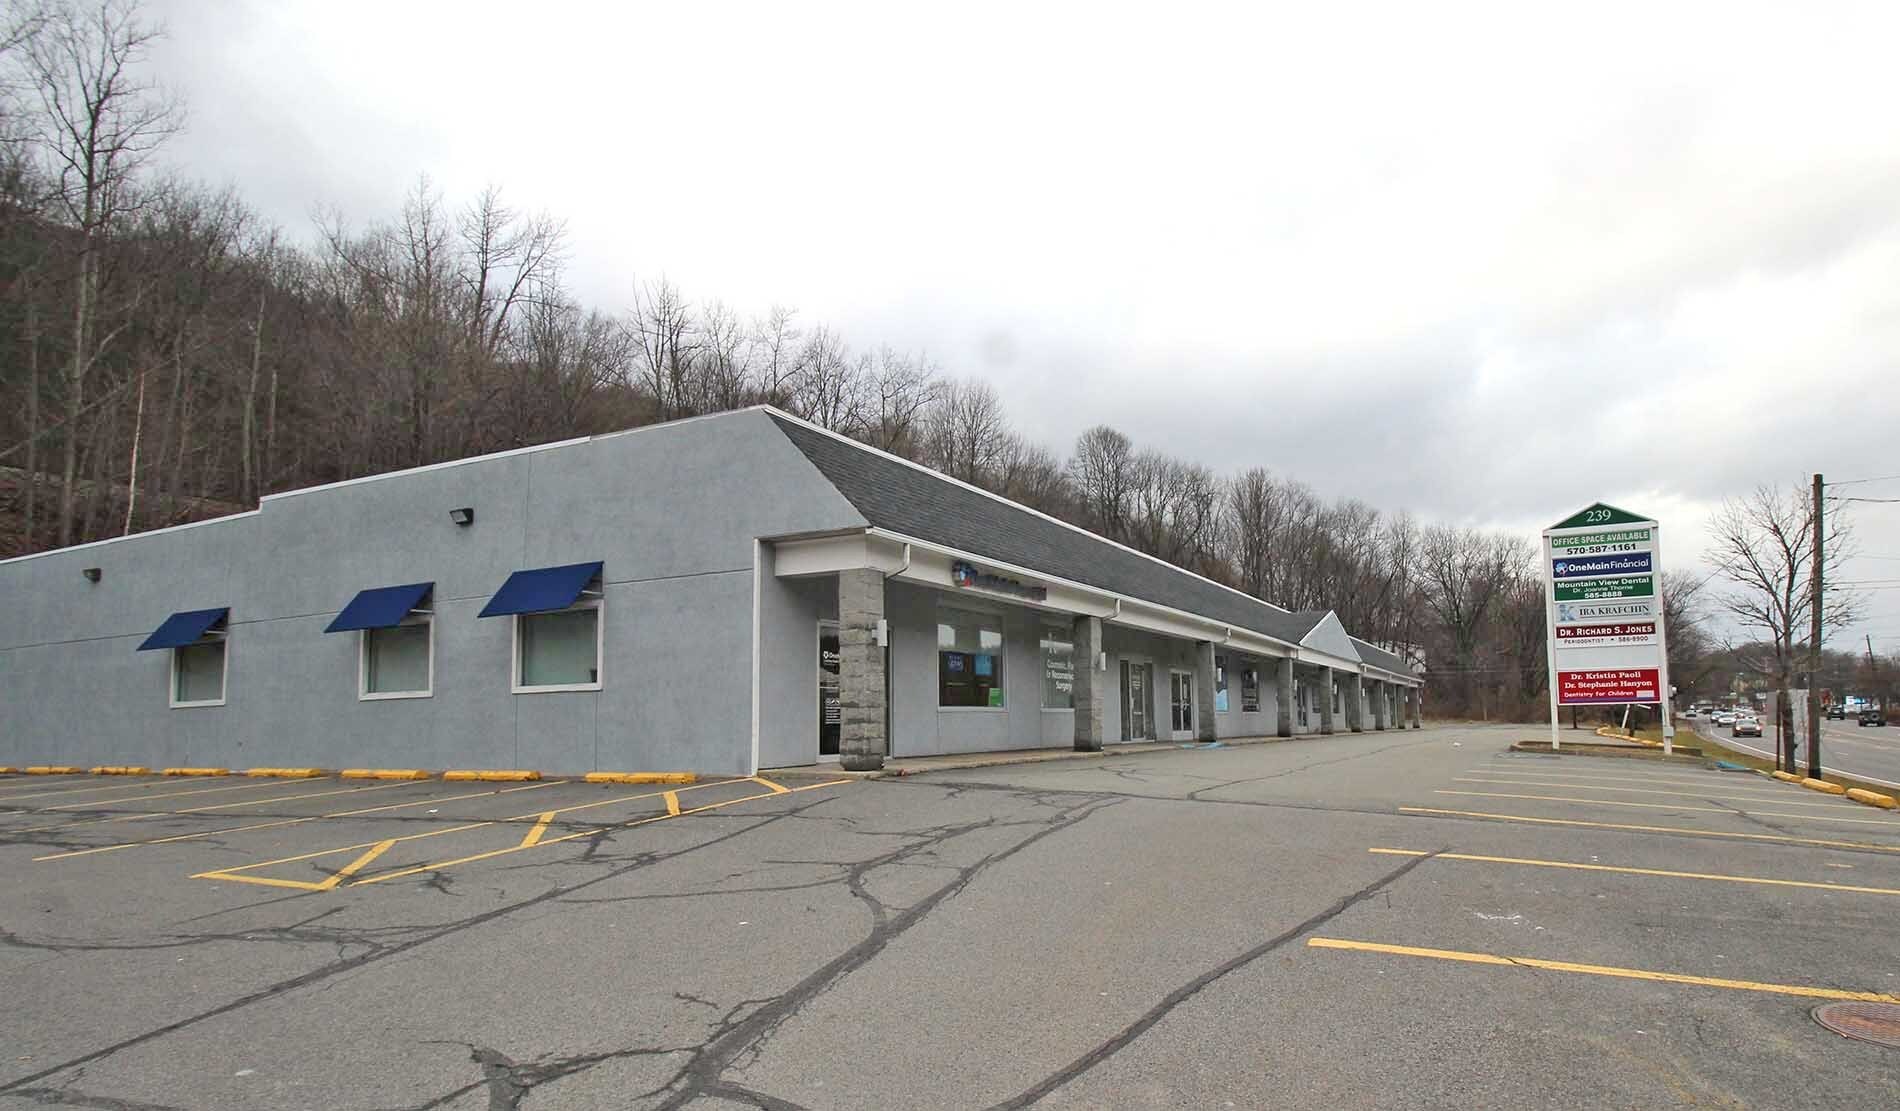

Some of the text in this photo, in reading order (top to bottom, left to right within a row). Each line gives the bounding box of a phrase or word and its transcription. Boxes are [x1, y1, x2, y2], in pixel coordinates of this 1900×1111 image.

[1586, 509, 1612, 522] 239
[1553, 531, 1649, 546] OFFICE SPACE AVAILABLE
[1557, 580, 1597, 589] Mountain
[1621, 577, 1650, 585] Dental
[1579, 608, 1595, 616] IRA
[1598, 605, 1649, 615] KRAFCHIN
[1577, 627, 1612, 636] RICHARD
[1625, 625, 1653, 633] JONES
[1578, 681, 1619, 689] Stephanie
[1620, 680, 1653, 688] Hanyon
